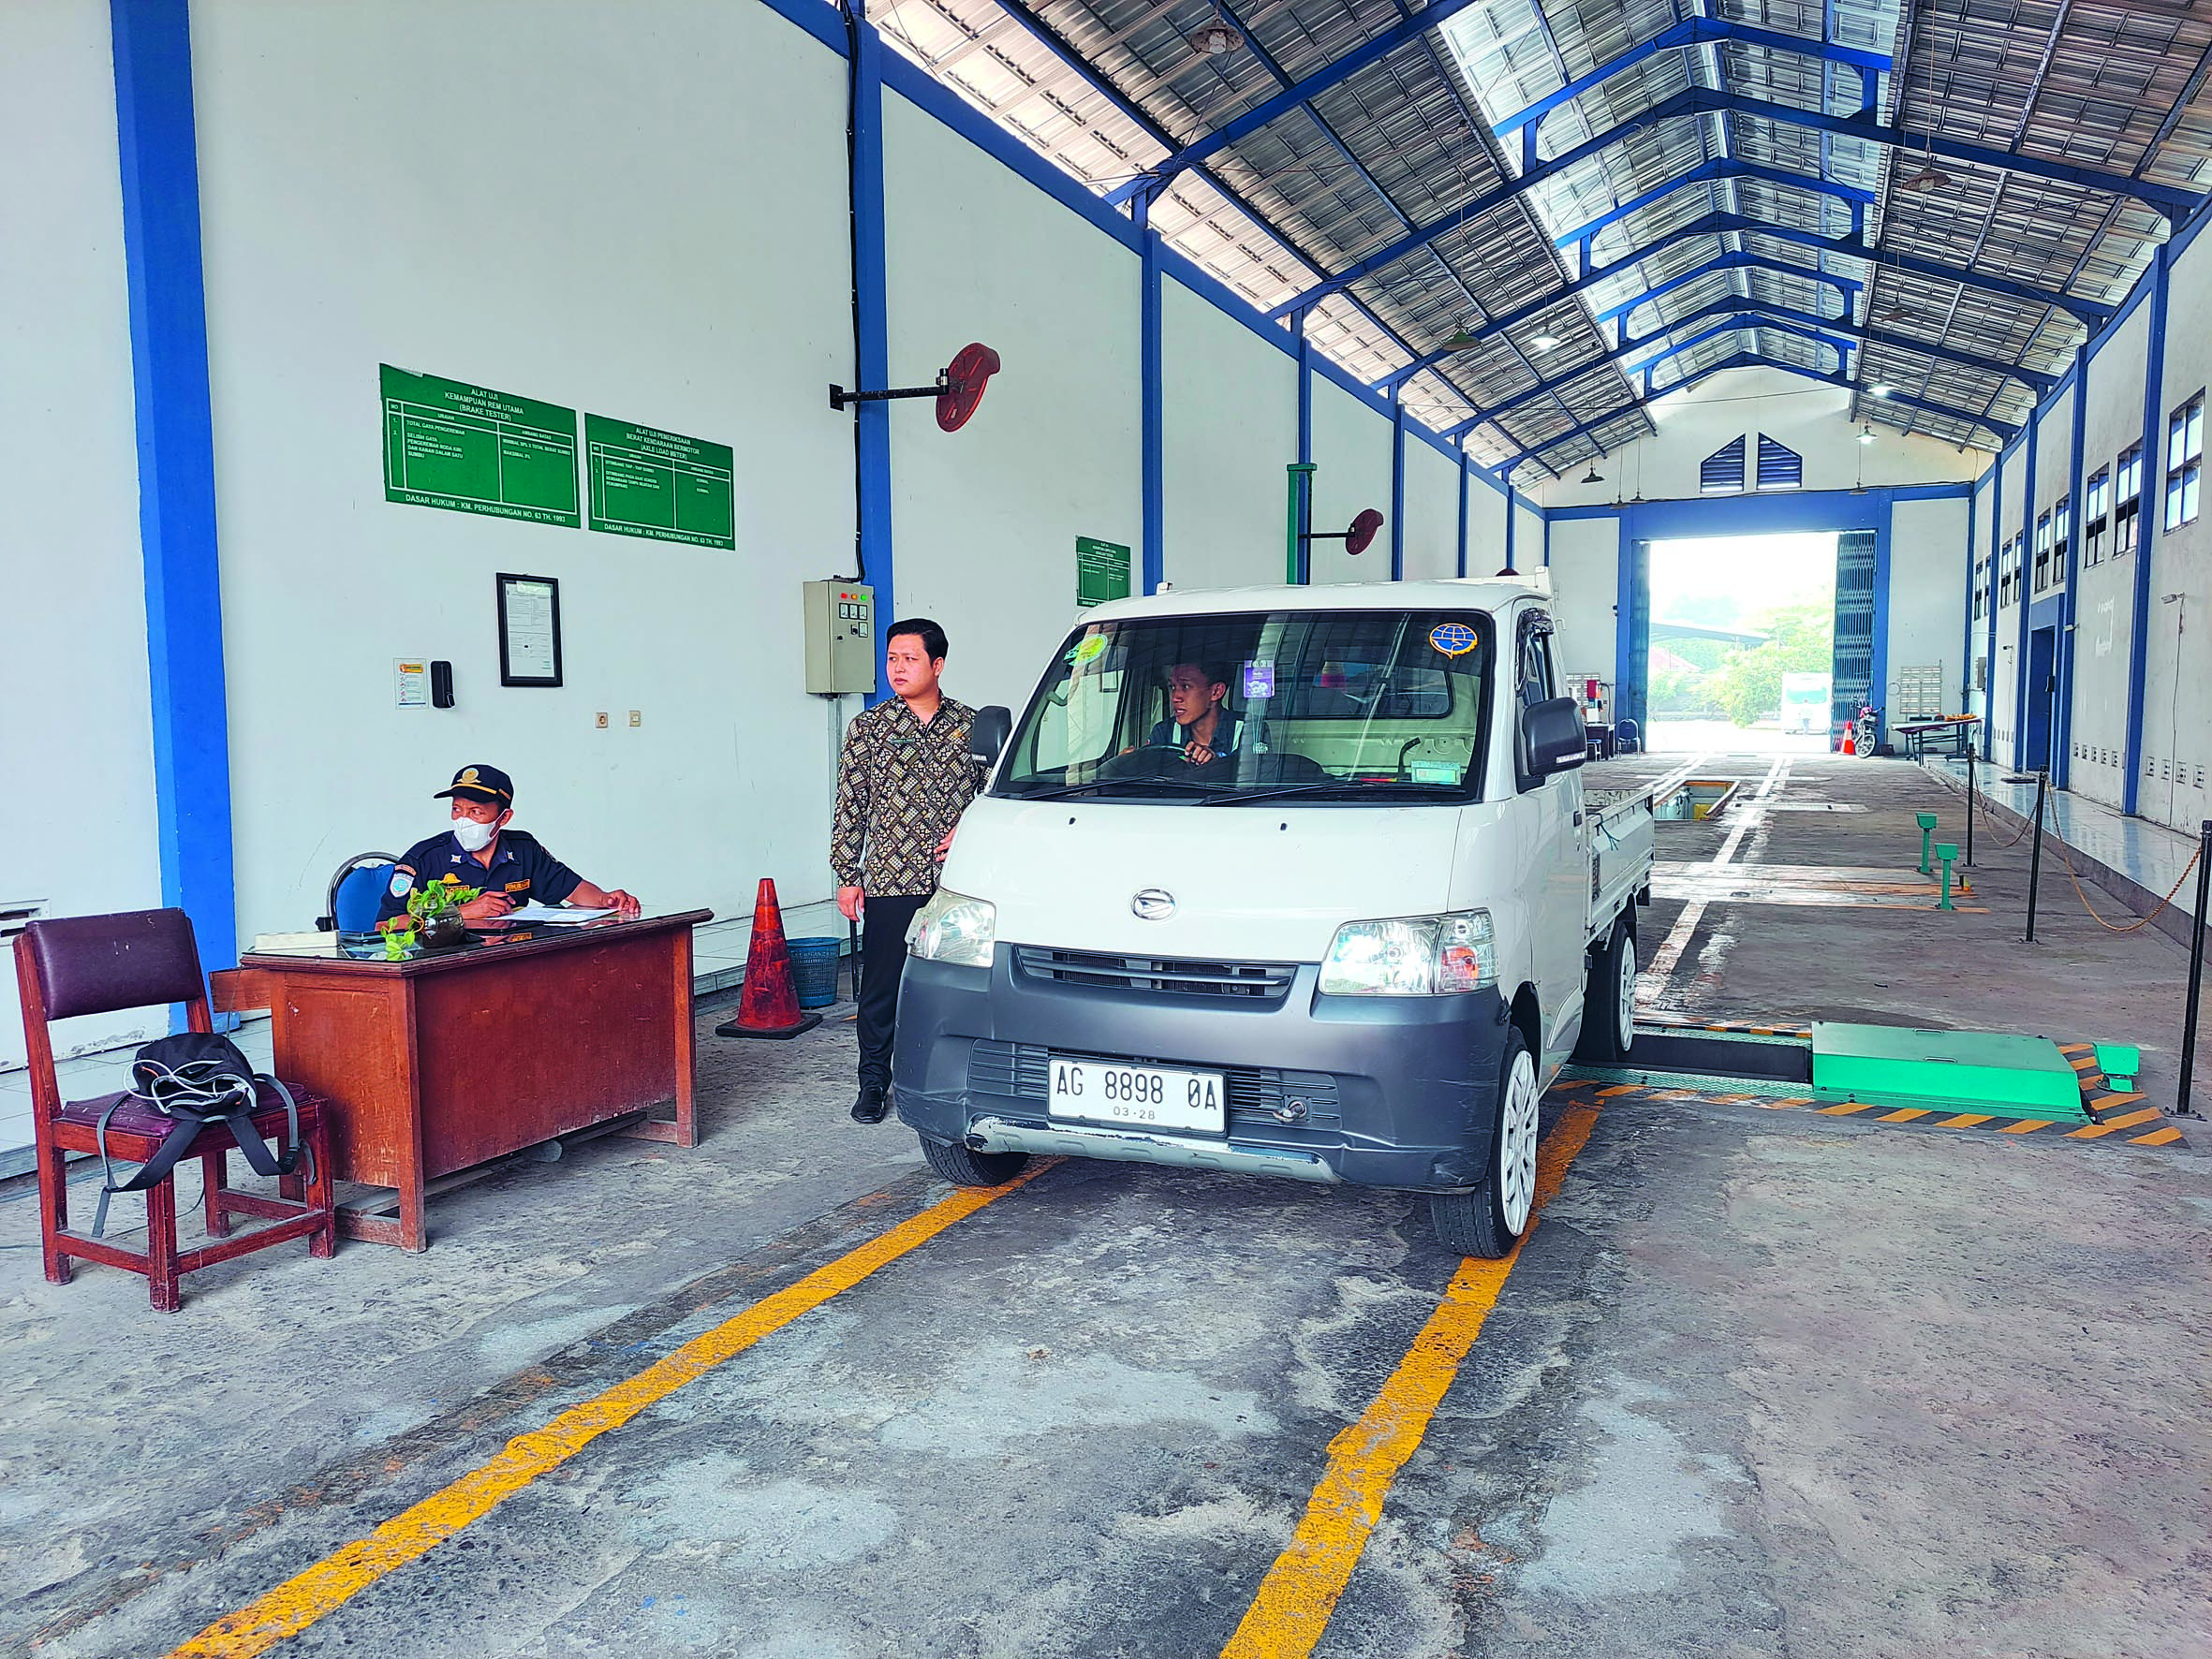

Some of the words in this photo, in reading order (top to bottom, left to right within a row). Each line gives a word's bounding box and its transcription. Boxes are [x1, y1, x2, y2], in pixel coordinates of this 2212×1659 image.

[445, 391, 486, 406] KEMAMPUAN
[488, 400, 501, 409] REM
[503, 403, 524, 415] UTAMA
[471, 389, 486, 398] ALAT
[489, 392, 498, 401] UJI
[459, 404, 483, 415] (BRAKE
[486, 409, 511, 421] TESTER)
[627, 433, 642, 441] BERAT
[643, 437, 673, 448] KENDARAAN
[674, 444, 700, 454] BERMOTOR
[657, 433, 691, 445] PEMERIKSAAN
[670, 451, 687, 460] METER)
[406, 494, 430, 504] DASAR
[431, 498, 455, 507] HUKUM
[461, 502, 473, 510] KM.
[475, 504, 522, 517] PERHUBUNGAN
[605, 523, 623, 532] DASAR
[656, 531, 690, 541] PERHUBUNGAN
[1057, 1065, 1084, 1095] AG
[1105, 1071, 1163, 1104] 8898
